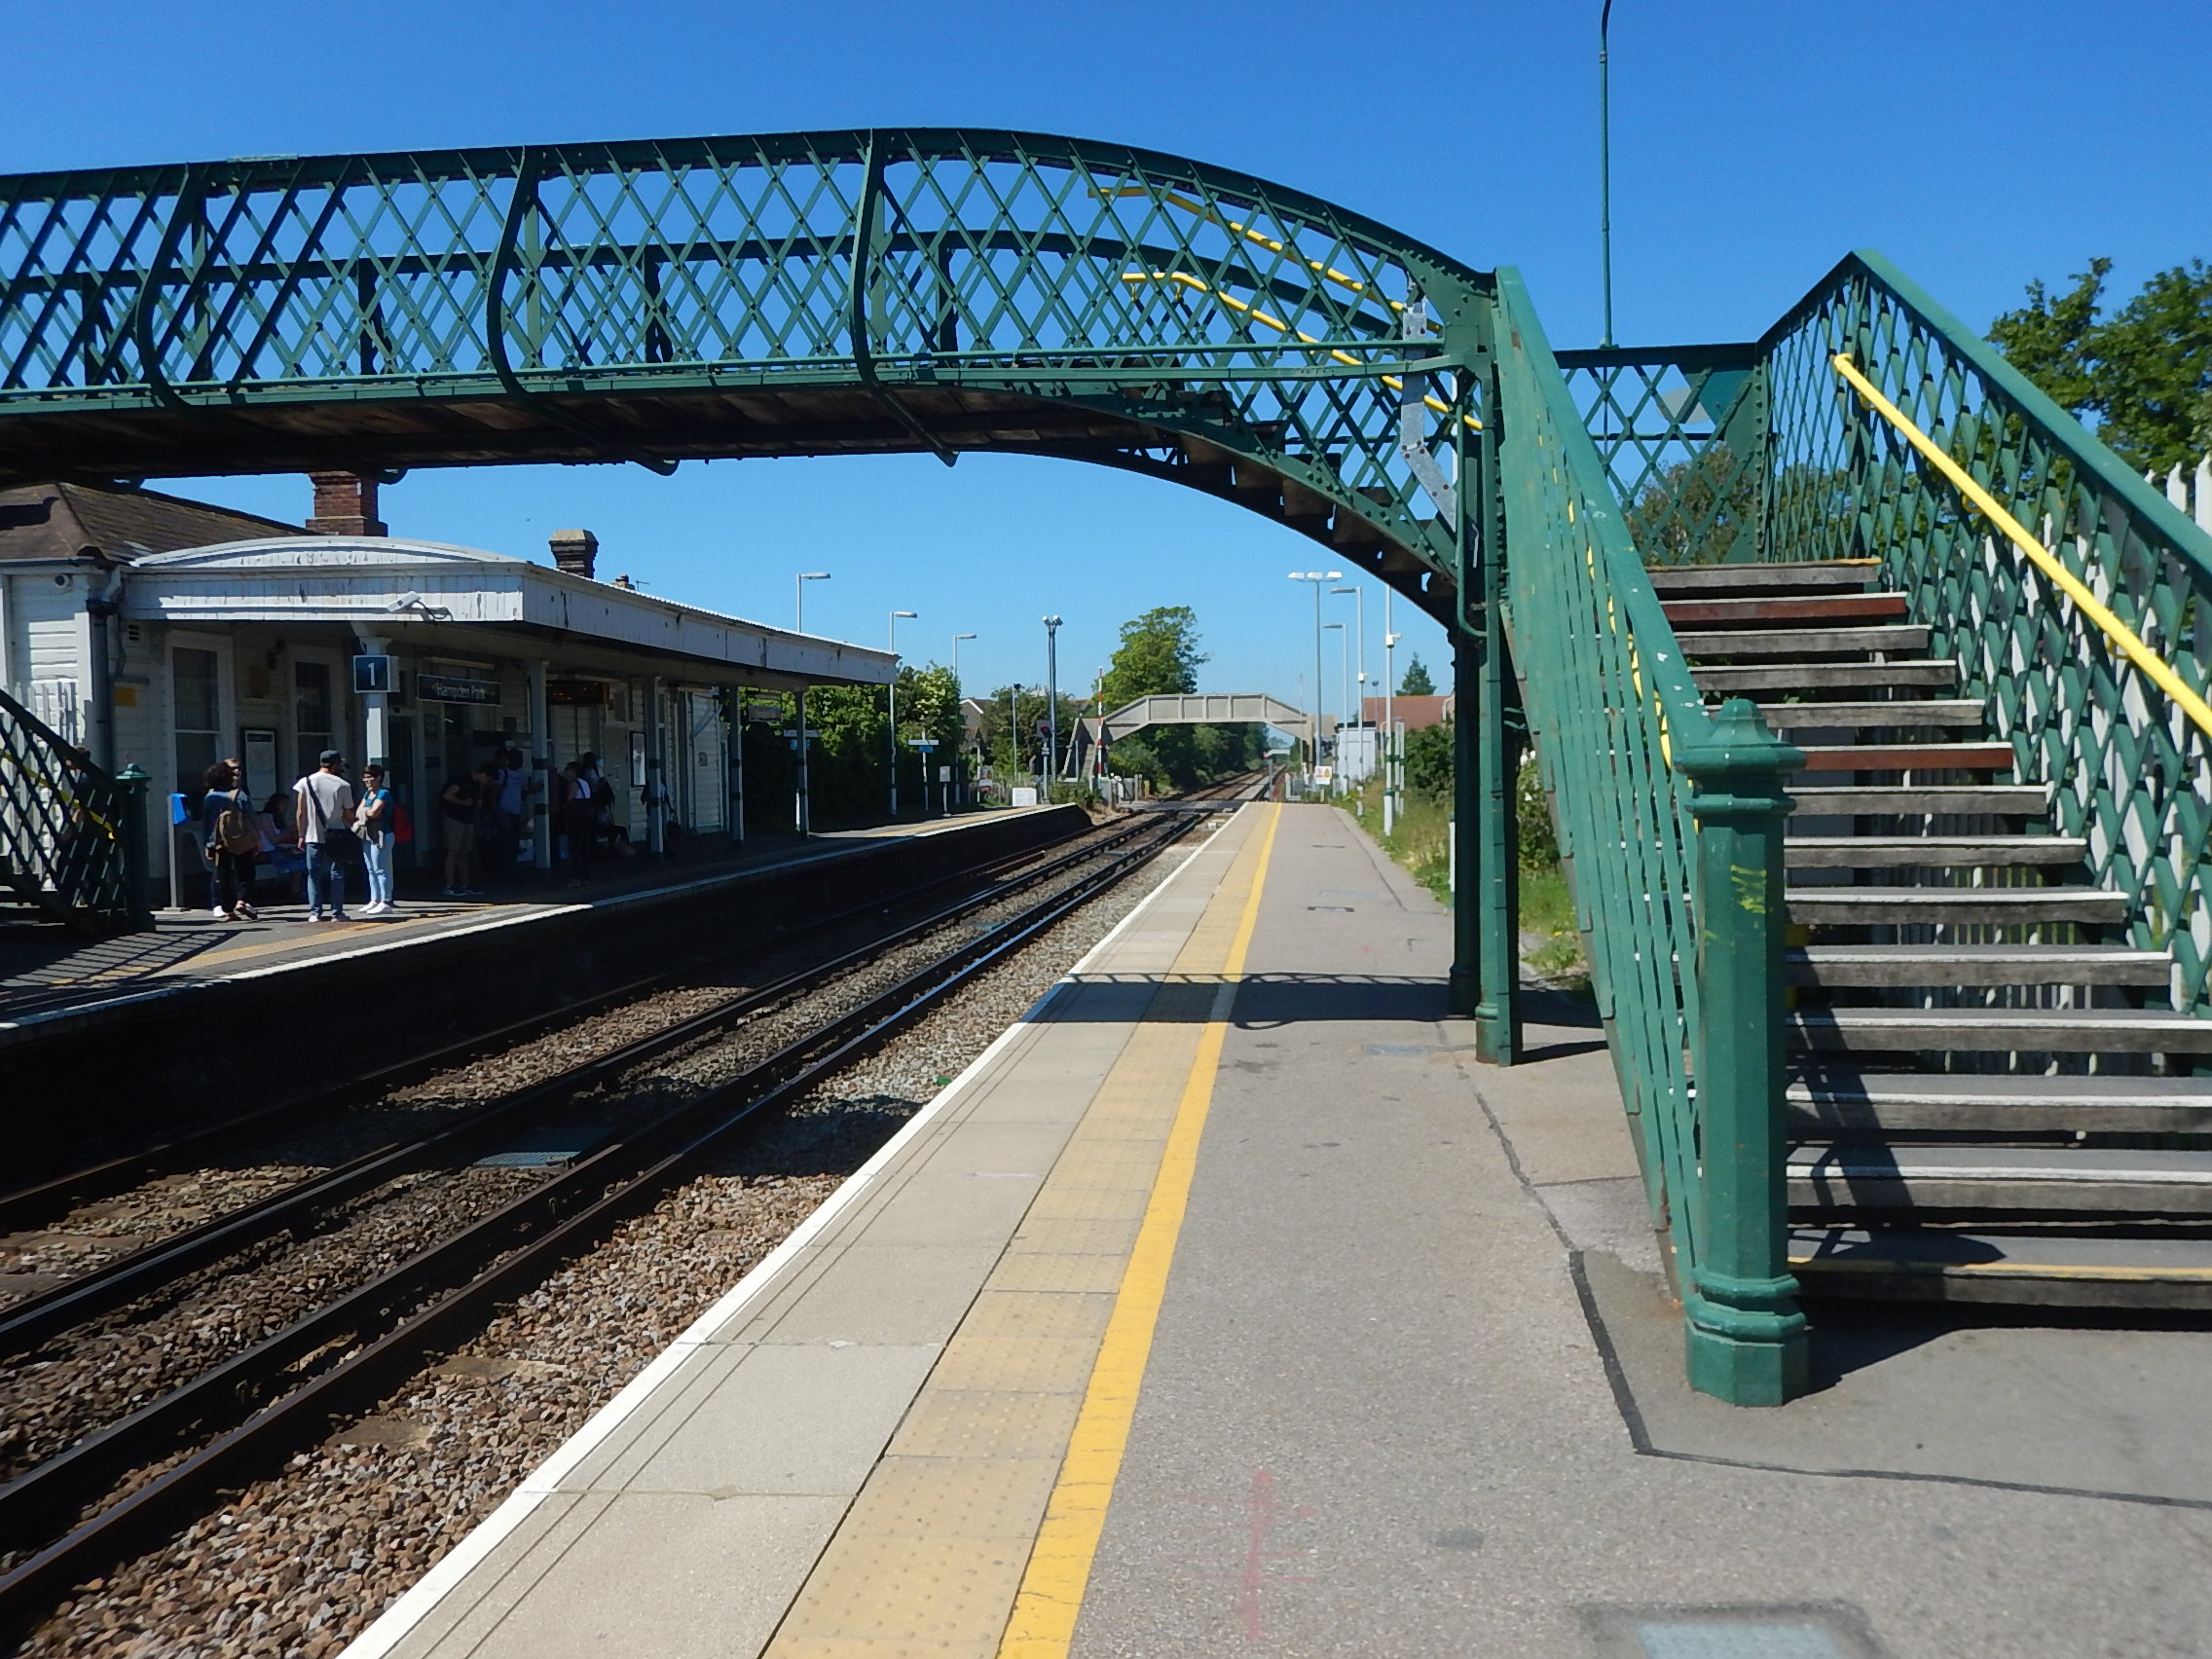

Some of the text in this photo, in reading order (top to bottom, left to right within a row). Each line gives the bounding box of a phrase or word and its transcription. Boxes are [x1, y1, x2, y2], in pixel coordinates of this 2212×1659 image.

[368, 662, 376, 685] 1
[436, 682, 487, 700] Hampden Park
